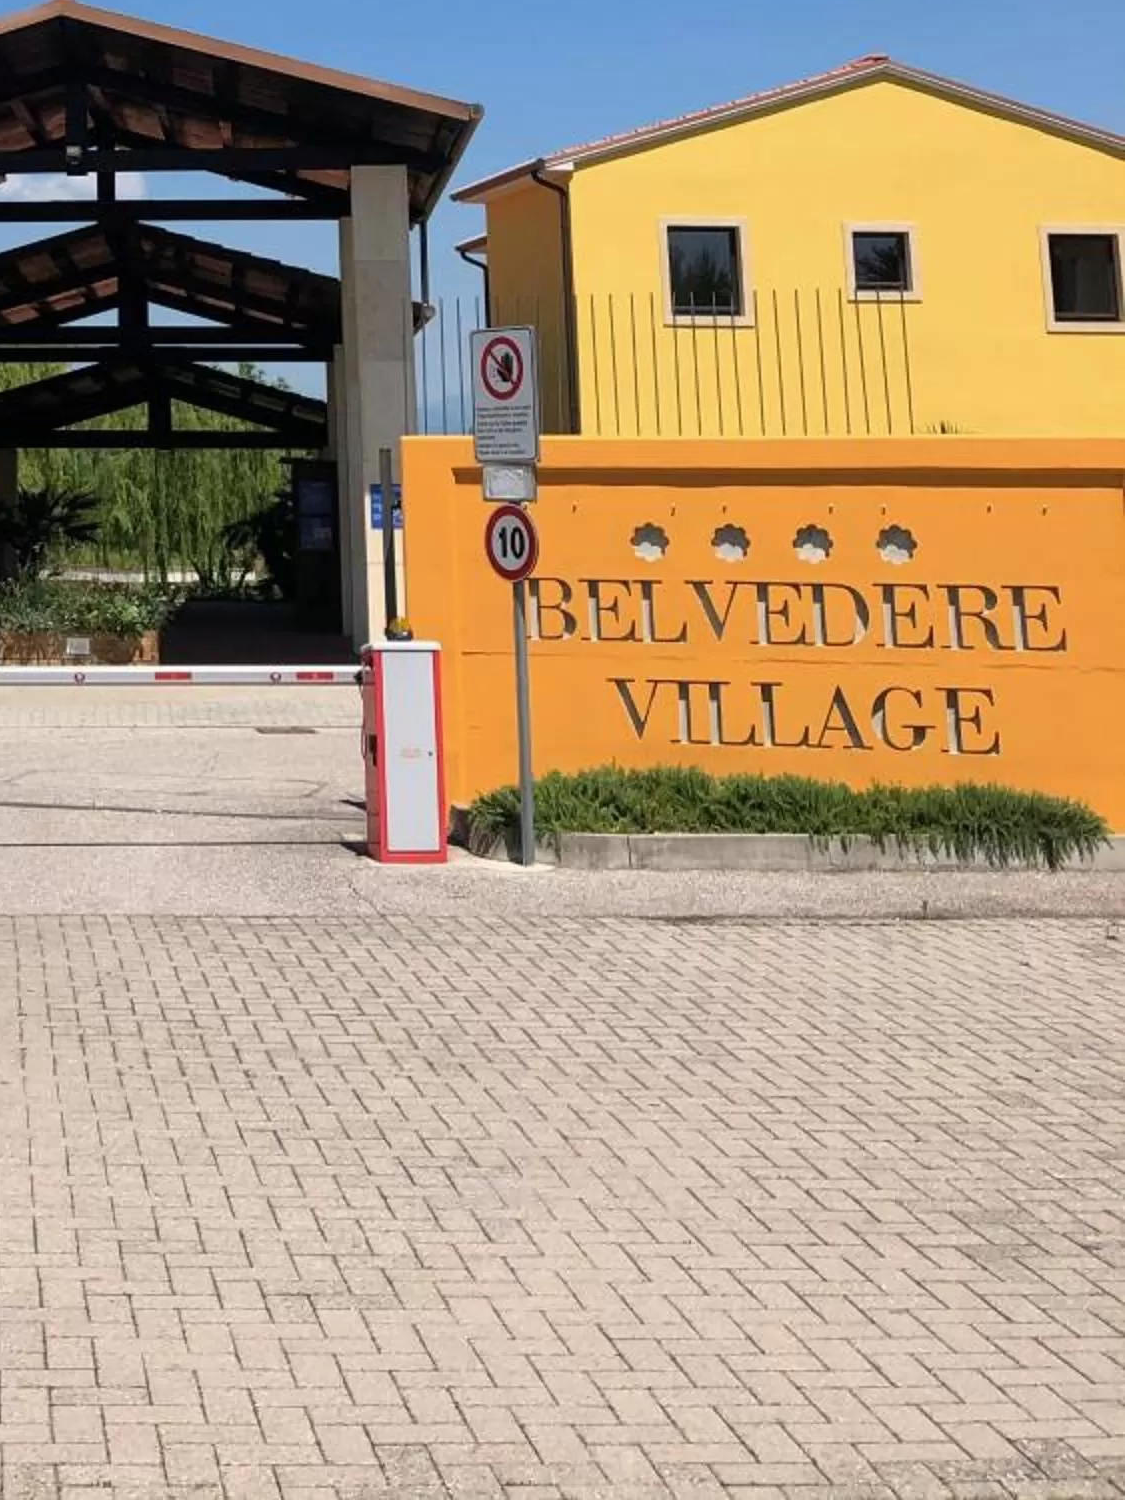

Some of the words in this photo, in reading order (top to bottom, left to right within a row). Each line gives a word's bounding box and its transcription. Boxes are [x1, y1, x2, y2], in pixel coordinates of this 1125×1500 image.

[498, 526, 525, 559] 10
[525, 576, 1067, 651] BELVEDERE
[606, 677, 1000, 756] VILLAGE
